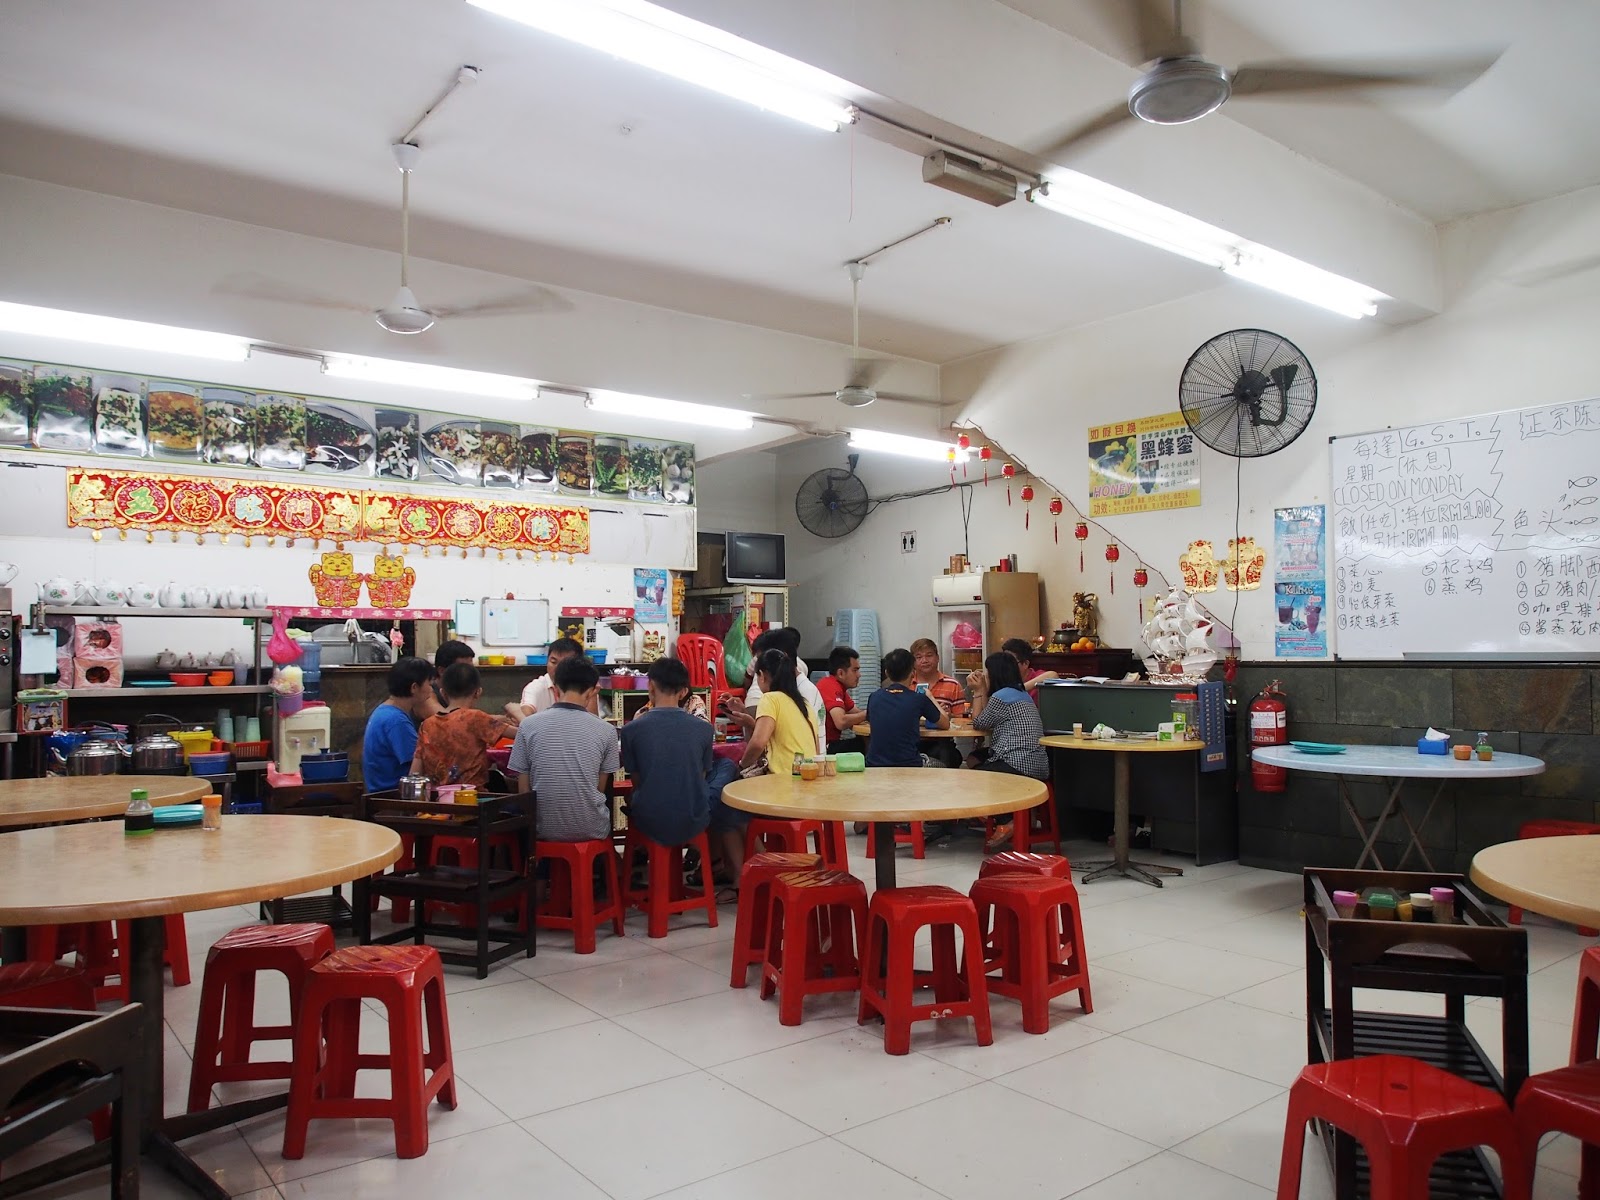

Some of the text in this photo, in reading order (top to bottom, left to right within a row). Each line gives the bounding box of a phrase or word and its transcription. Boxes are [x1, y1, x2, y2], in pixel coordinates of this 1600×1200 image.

[1525, 405, 1600, 433] 正宗陈
[1140, 434, 1193, 460] 黑蜂蜜
[1353, 434, 1397, 460] 每逢
[1093, 482, 1133, 498] HONEY
[1334, 473, 1464, 506] CLOSED ON MONDAY
